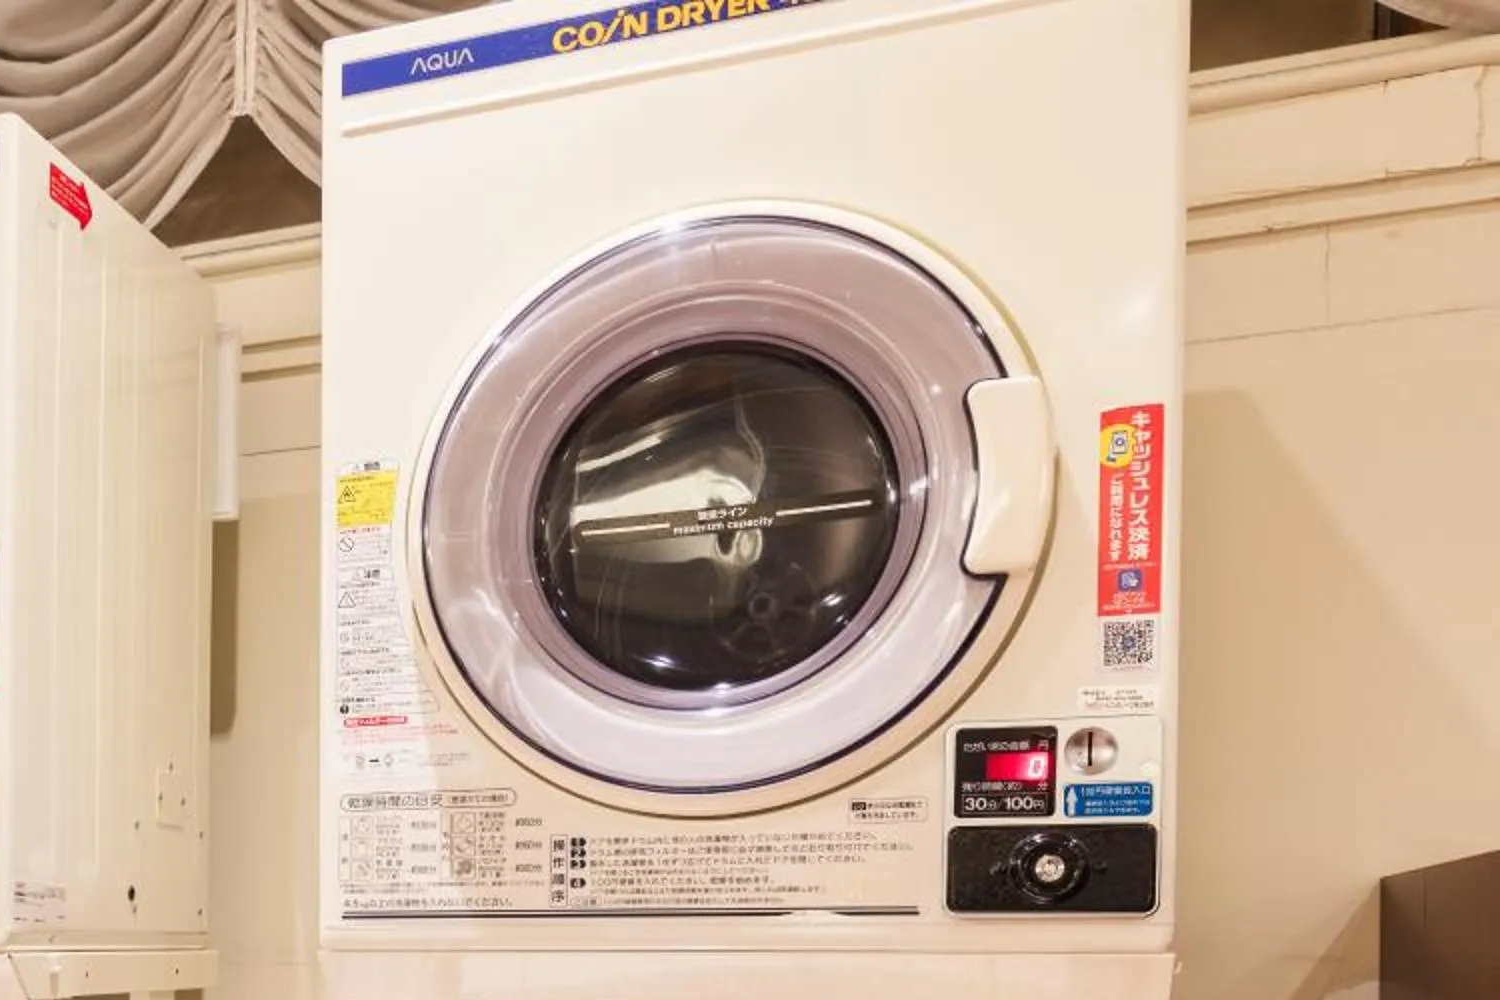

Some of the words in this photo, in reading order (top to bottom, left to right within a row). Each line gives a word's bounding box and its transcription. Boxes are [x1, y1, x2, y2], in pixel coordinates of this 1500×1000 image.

[411, 46, 475, 76] AQUA
[1128, 411, 1152, 561] キャッシュレス決済
[727, 516, 775, 531] capacity
[1028, 752, 1047, 779] 0
